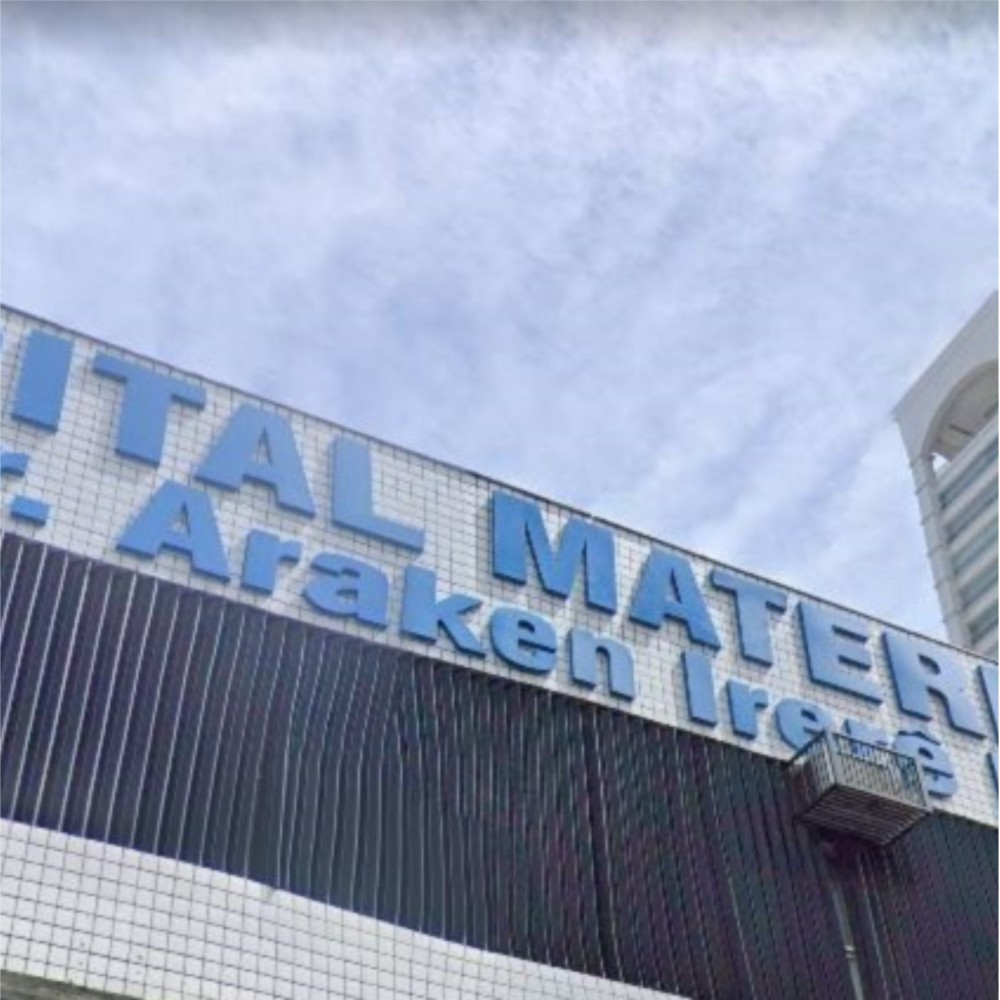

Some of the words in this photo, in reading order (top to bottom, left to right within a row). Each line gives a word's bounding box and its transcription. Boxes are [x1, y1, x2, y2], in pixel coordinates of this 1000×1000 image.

[0, 329, 425, 553] ITAL
[491, 489, 998, 744] MATER
[117, 480, 634, 701] Araken
